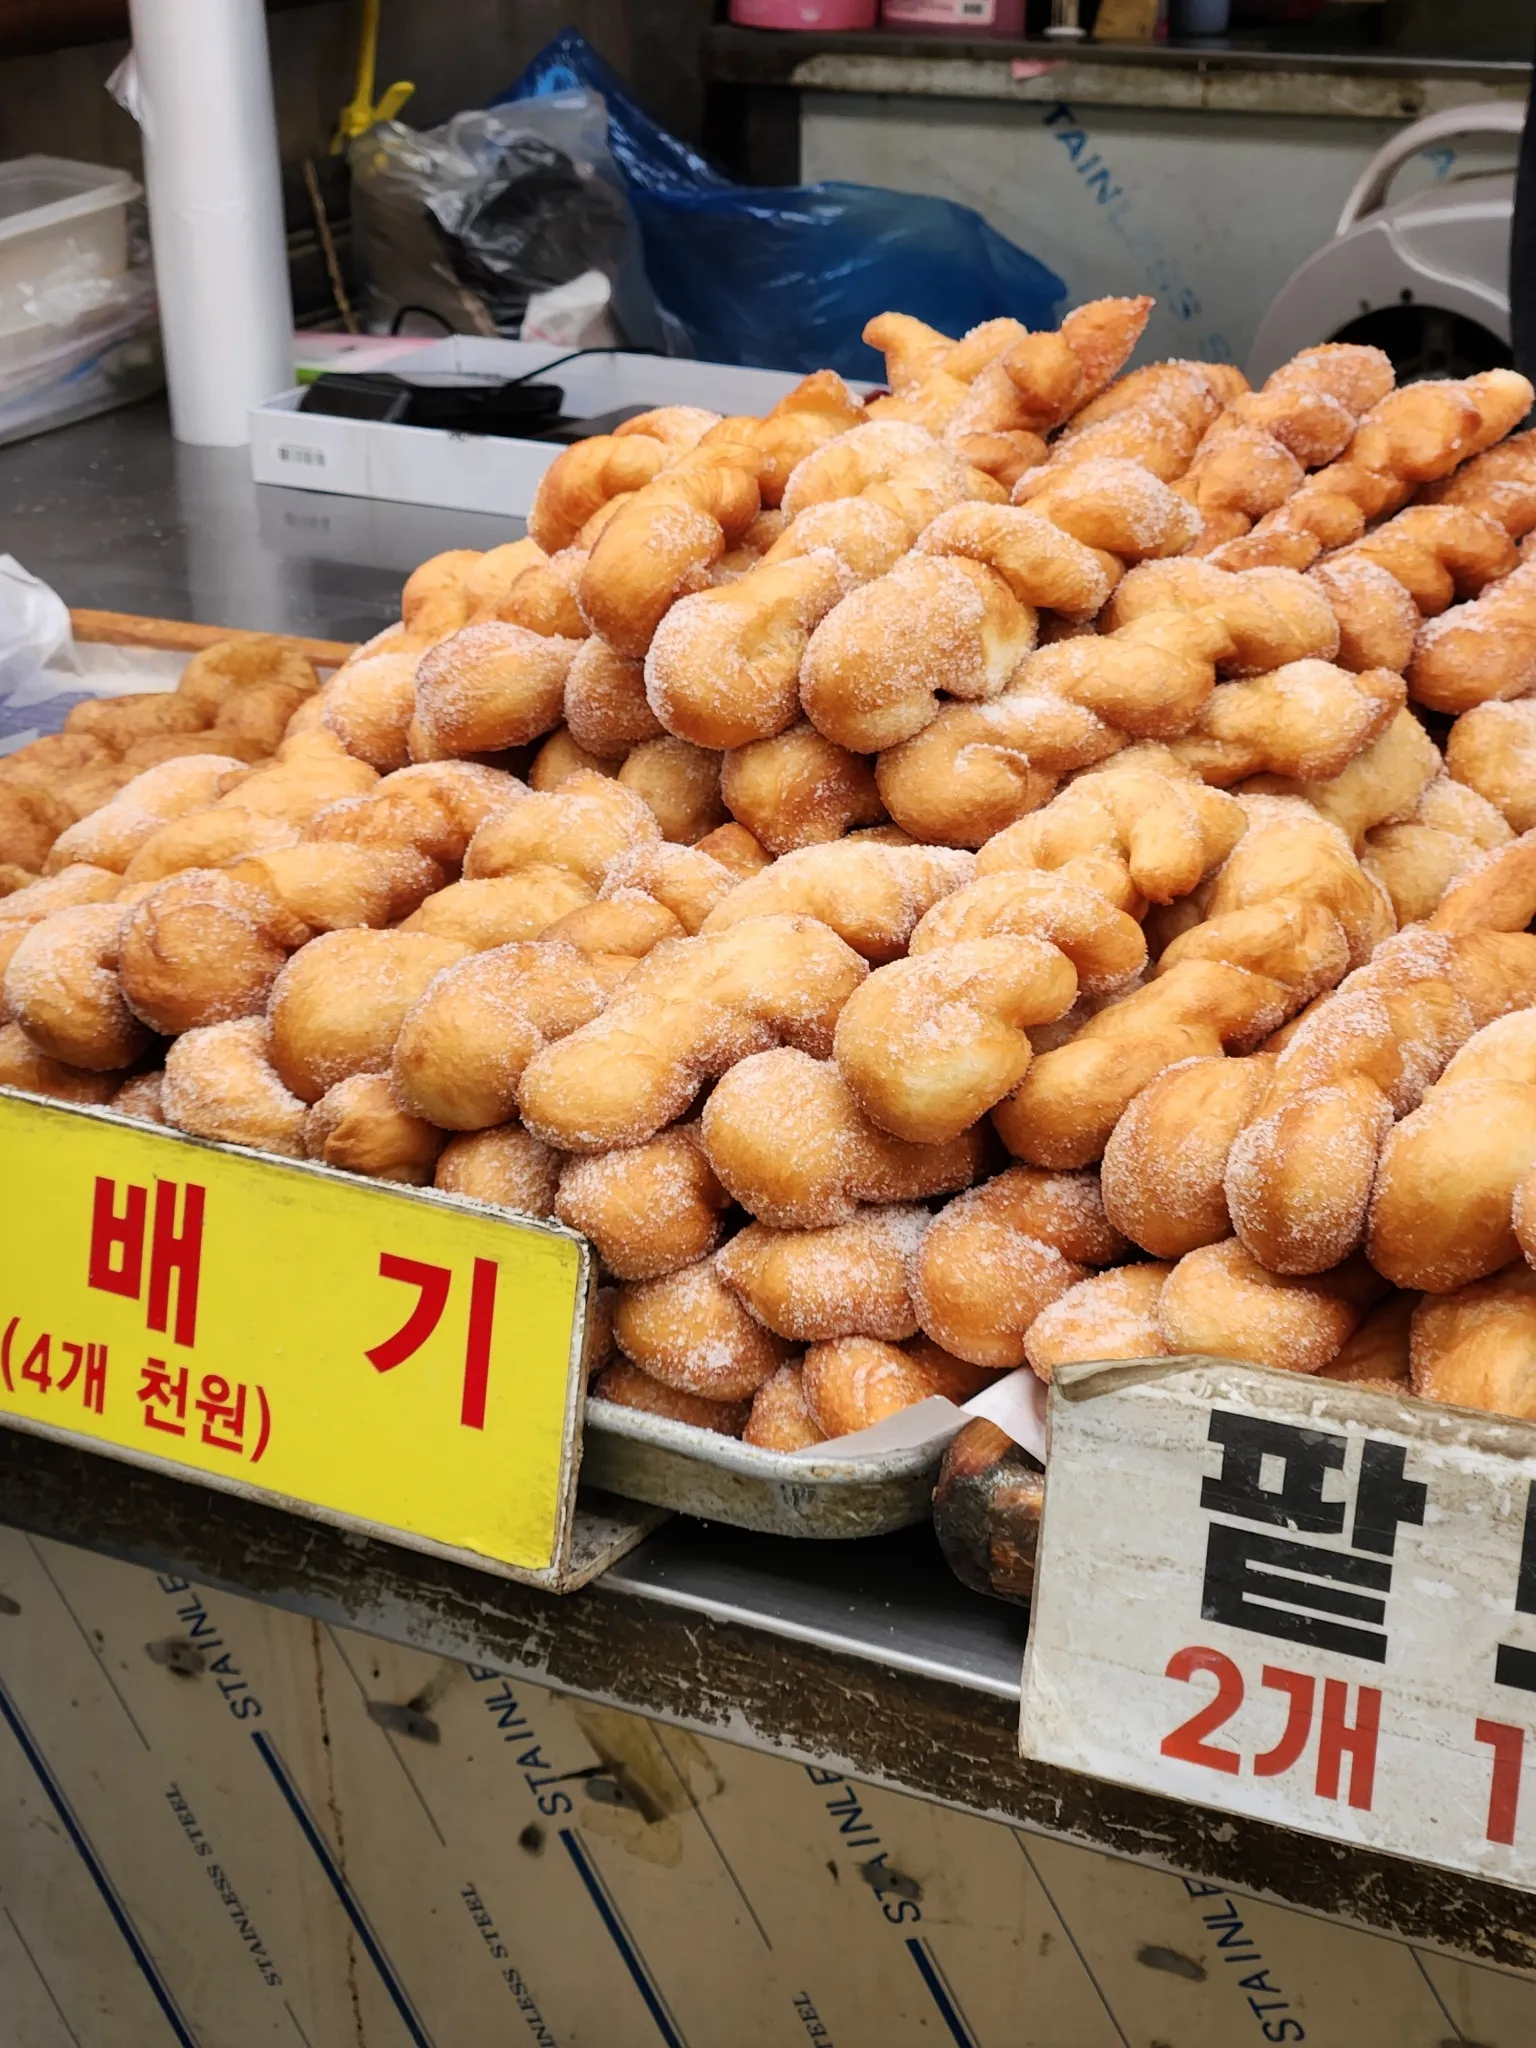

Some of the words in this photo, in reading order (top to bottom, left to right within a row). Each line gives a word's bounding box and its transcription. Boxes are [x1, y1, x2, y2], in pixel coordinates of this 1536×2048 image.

[1, 1316, 108, 1415] (4개
[136, 1356, 271, 1463] 천원)
[1160, 1645, 1383, 1812] 2개
[165, 1782, 213, 1857] STEEL
[206, 1864, 283, 1987] STAINLESS
[461, 1881, 509, 1959] STEEL
